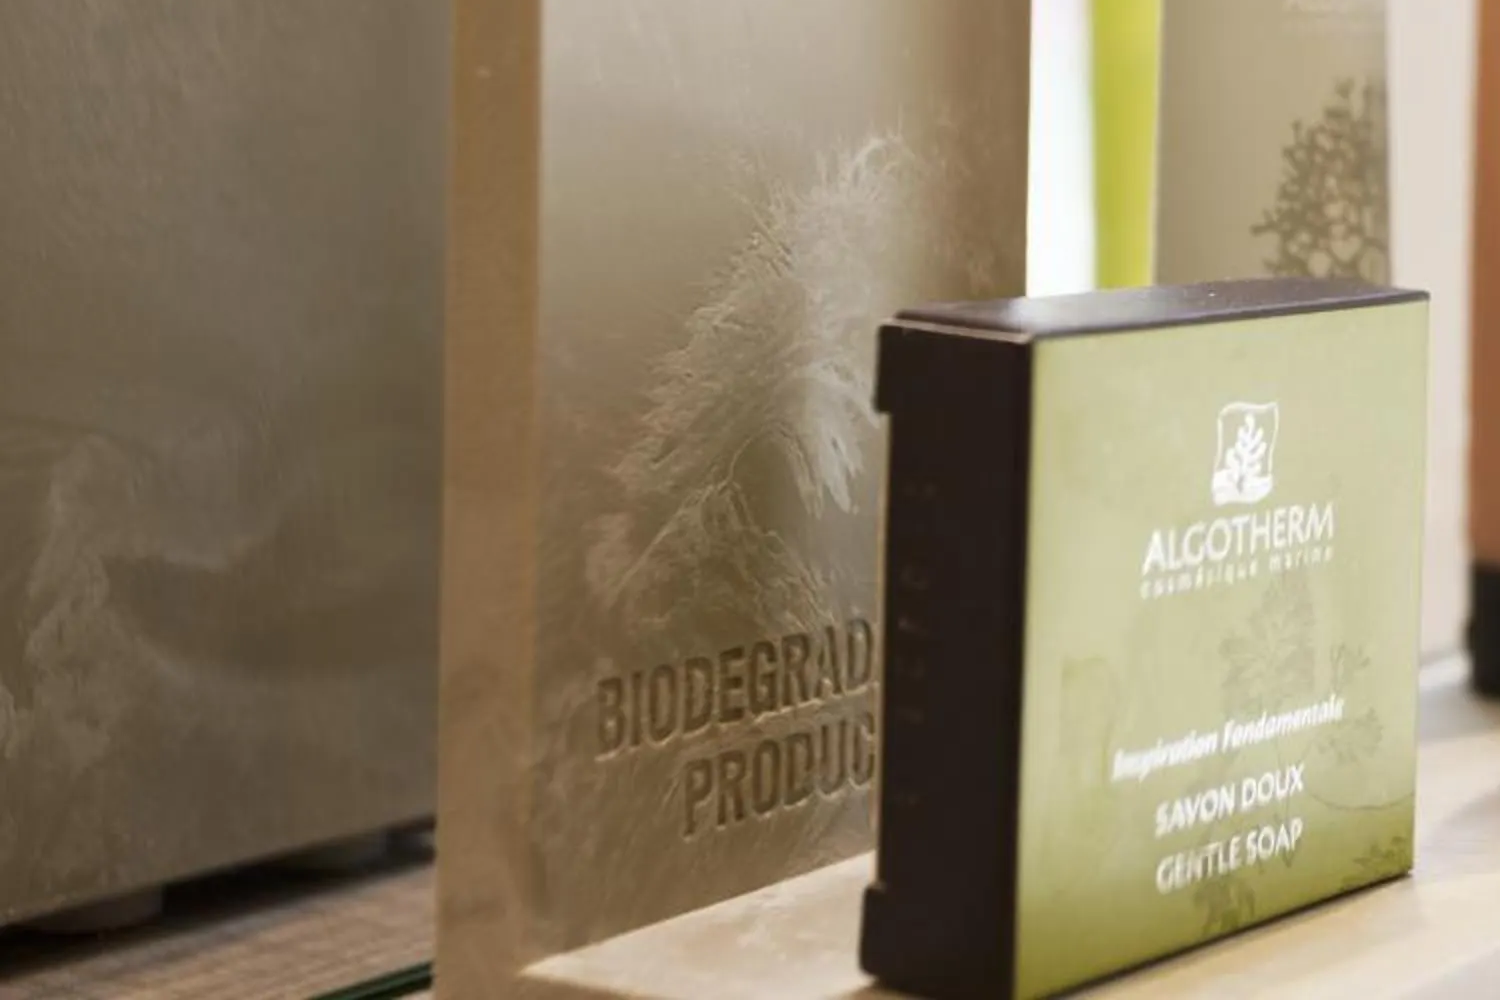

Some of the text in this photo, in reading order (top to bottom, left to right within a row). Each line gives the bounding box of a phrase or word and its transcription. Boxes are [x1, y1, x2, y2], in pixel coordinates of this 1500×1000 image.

[1142, 501, 1335, 576] ALGOTHERM
[596, 616, 874, 754] BIODEGRAD
[682, 710, 876, 838] PRODUC
[1155, 762, 1306, 838] SAVON DOUX
[1156, 818, 1304, 894] GENTLE SOAP
